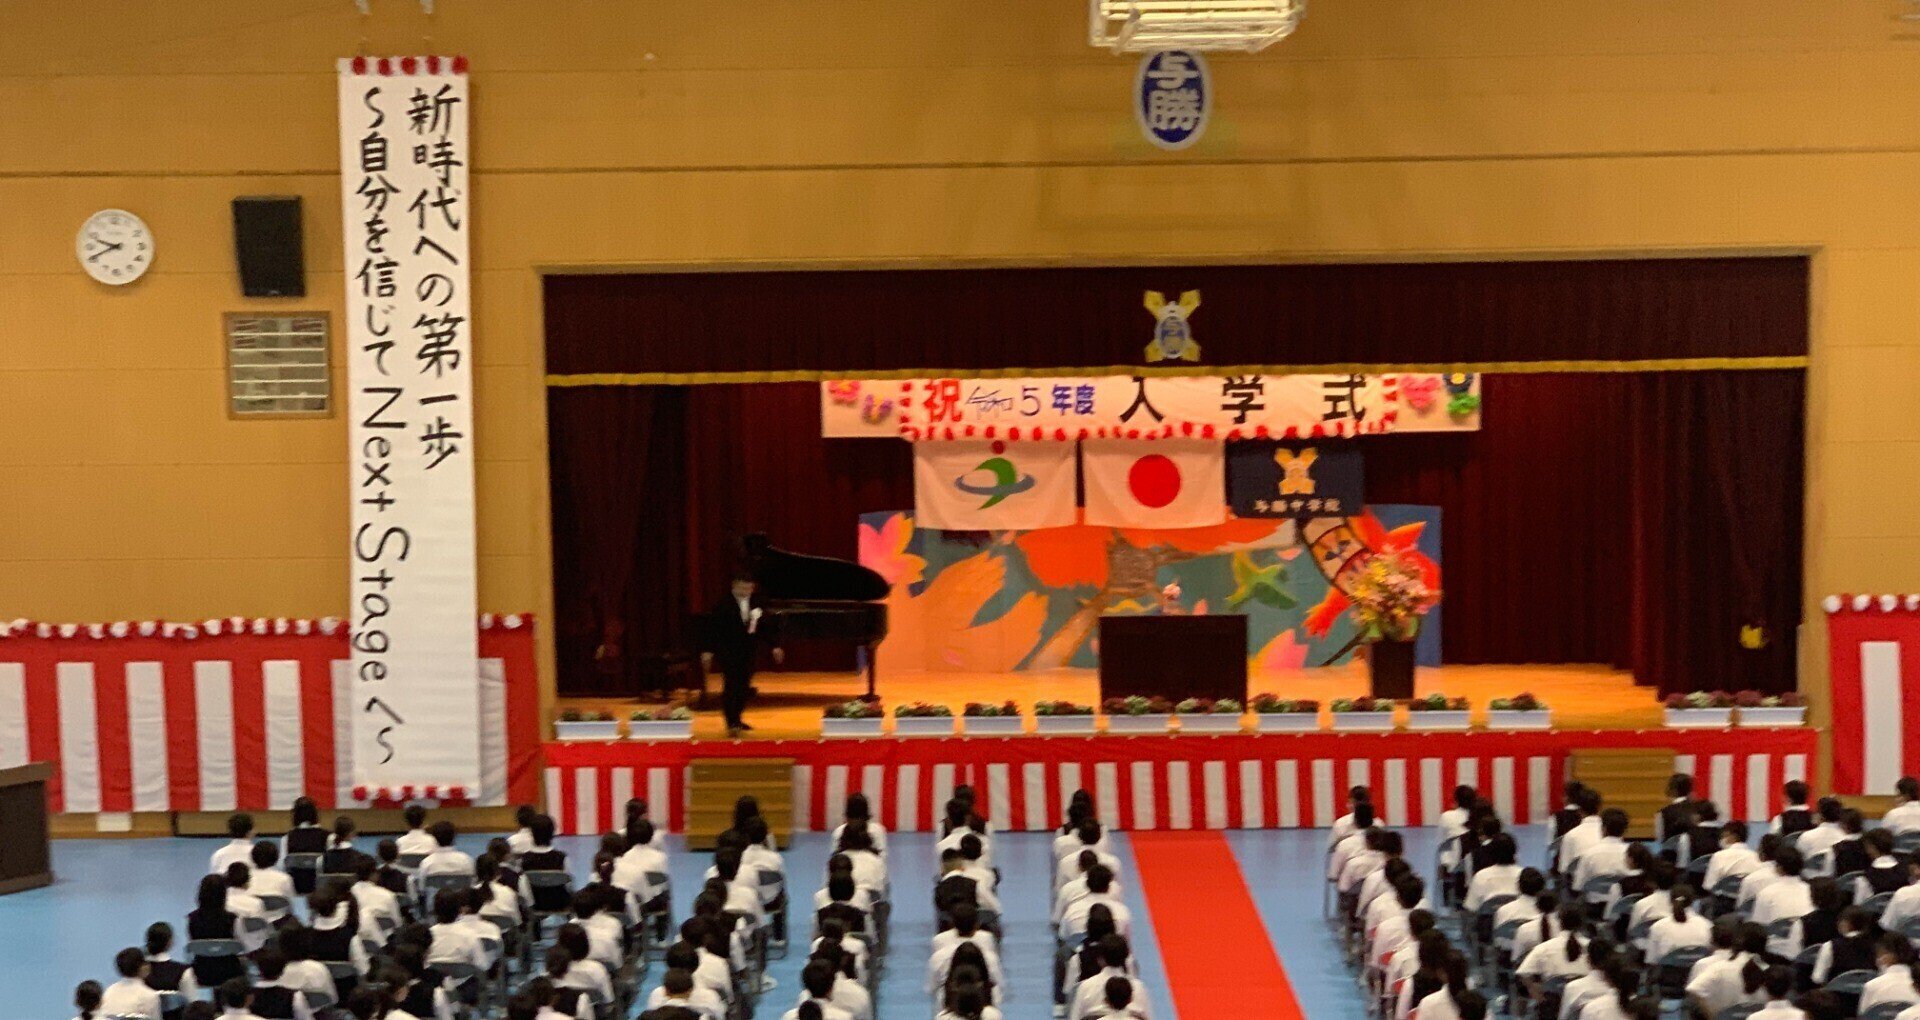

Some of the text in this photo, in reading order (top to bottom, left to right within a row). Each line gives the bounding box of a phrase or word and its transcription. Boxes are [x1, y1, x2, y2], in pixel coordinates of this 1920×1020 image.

[1147, 52, 1201, 131] 与勝
[406, 84, 466, 470] 新時代への第一歩
